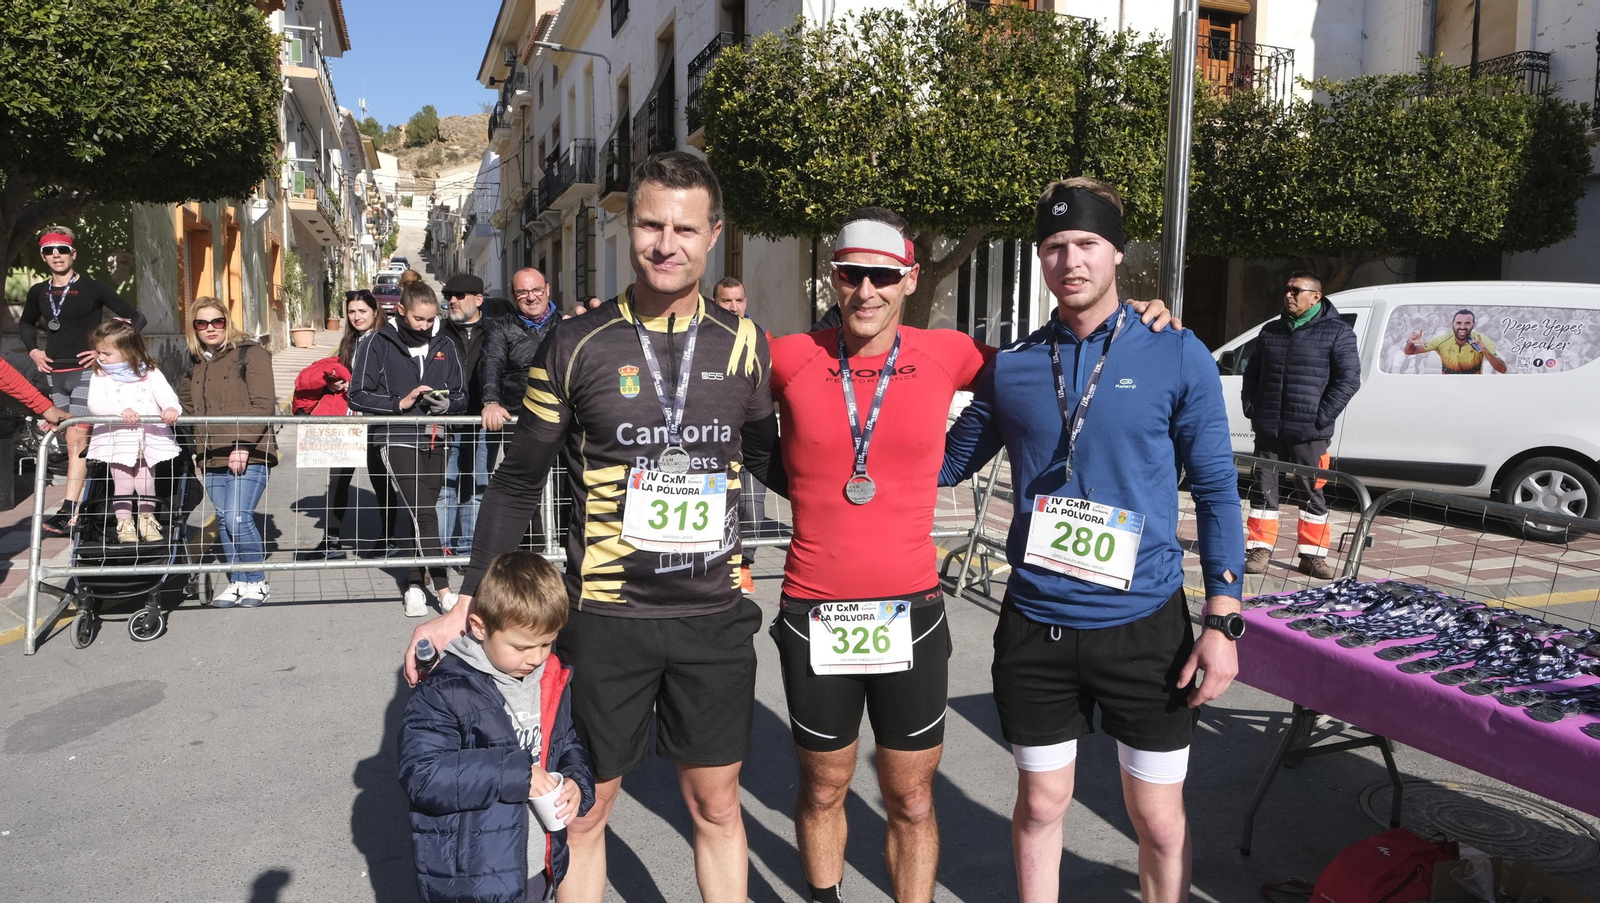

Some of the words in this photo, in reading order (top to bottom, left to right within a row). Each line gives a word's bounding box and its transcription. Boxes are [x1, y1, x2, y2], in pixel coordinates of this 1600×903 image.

[1502, 317, 1538, 337] Pepe
[1542, 318, 1583, 338] Yepes
[1511, 336, 1571, 355] Speaker
[635, 456, 719, 471] Ruers
[646, 472, 658, 481] IV
[661, 474, 686, 484] CxM
[641, 483, 653, 492] LA
[657, 485, 700, 496] PÓLVORA
[1051, 497, 1063, 505] IV
[1066, 499, 1091, 511] CxM
[648, 499, 709, 531] 313
[1045, 506, 1058, 514] LA
[1061, 508, 1104, 525] PÓLVORA
[1050, 521, 1116, 562] 280
[823, 604, 833, 612] IV
[836, 604, 859, 612] CxM
[834, 613, 875, 622] PÓLVORA
[832, 625, 891, 654] 326
